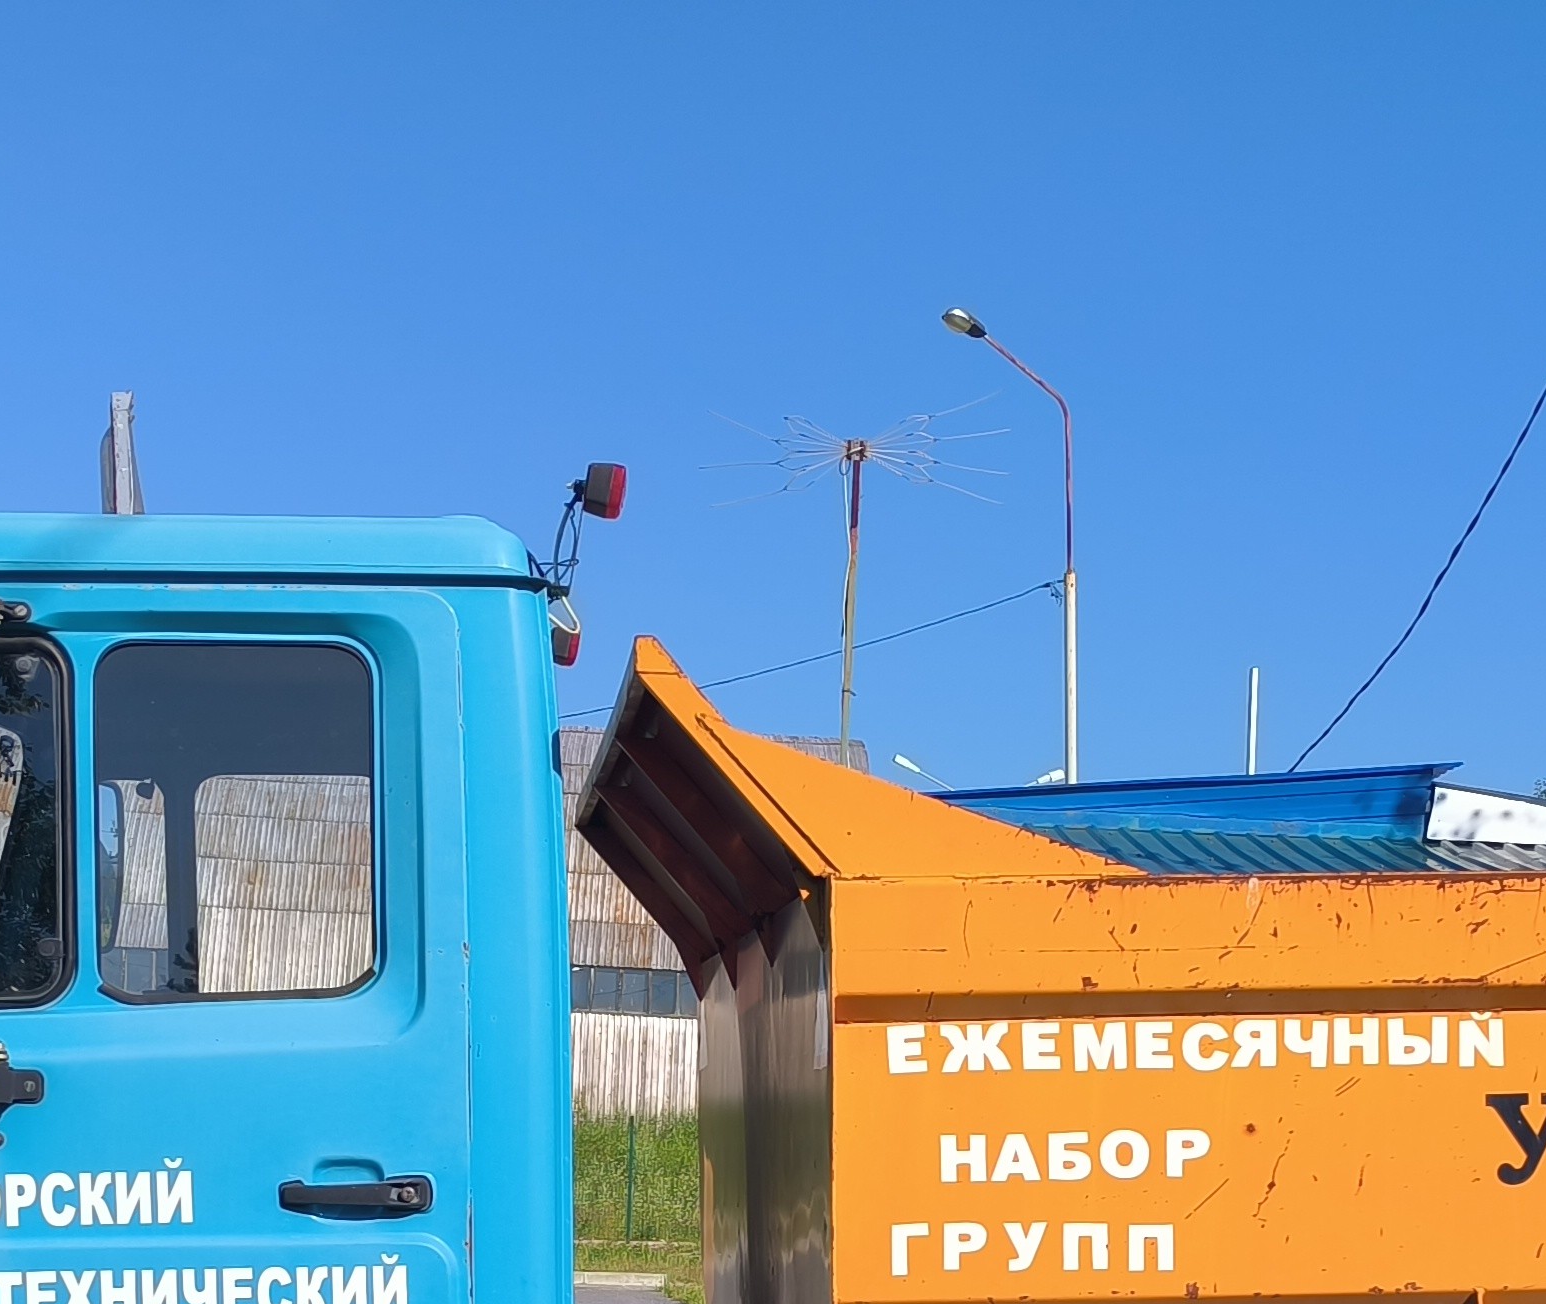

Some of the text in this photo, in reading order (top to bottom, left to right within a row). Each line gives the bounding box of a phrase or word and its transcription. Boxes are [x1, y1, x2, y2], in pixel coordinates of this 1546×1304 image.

[886, 1011, 1506, 1074] ЕЖЕМЕСЯЧНЫЙ
[939, 1129, 1212, 1183] НАБОР
[890, 1220, 1175, 1276] ГРУПП
